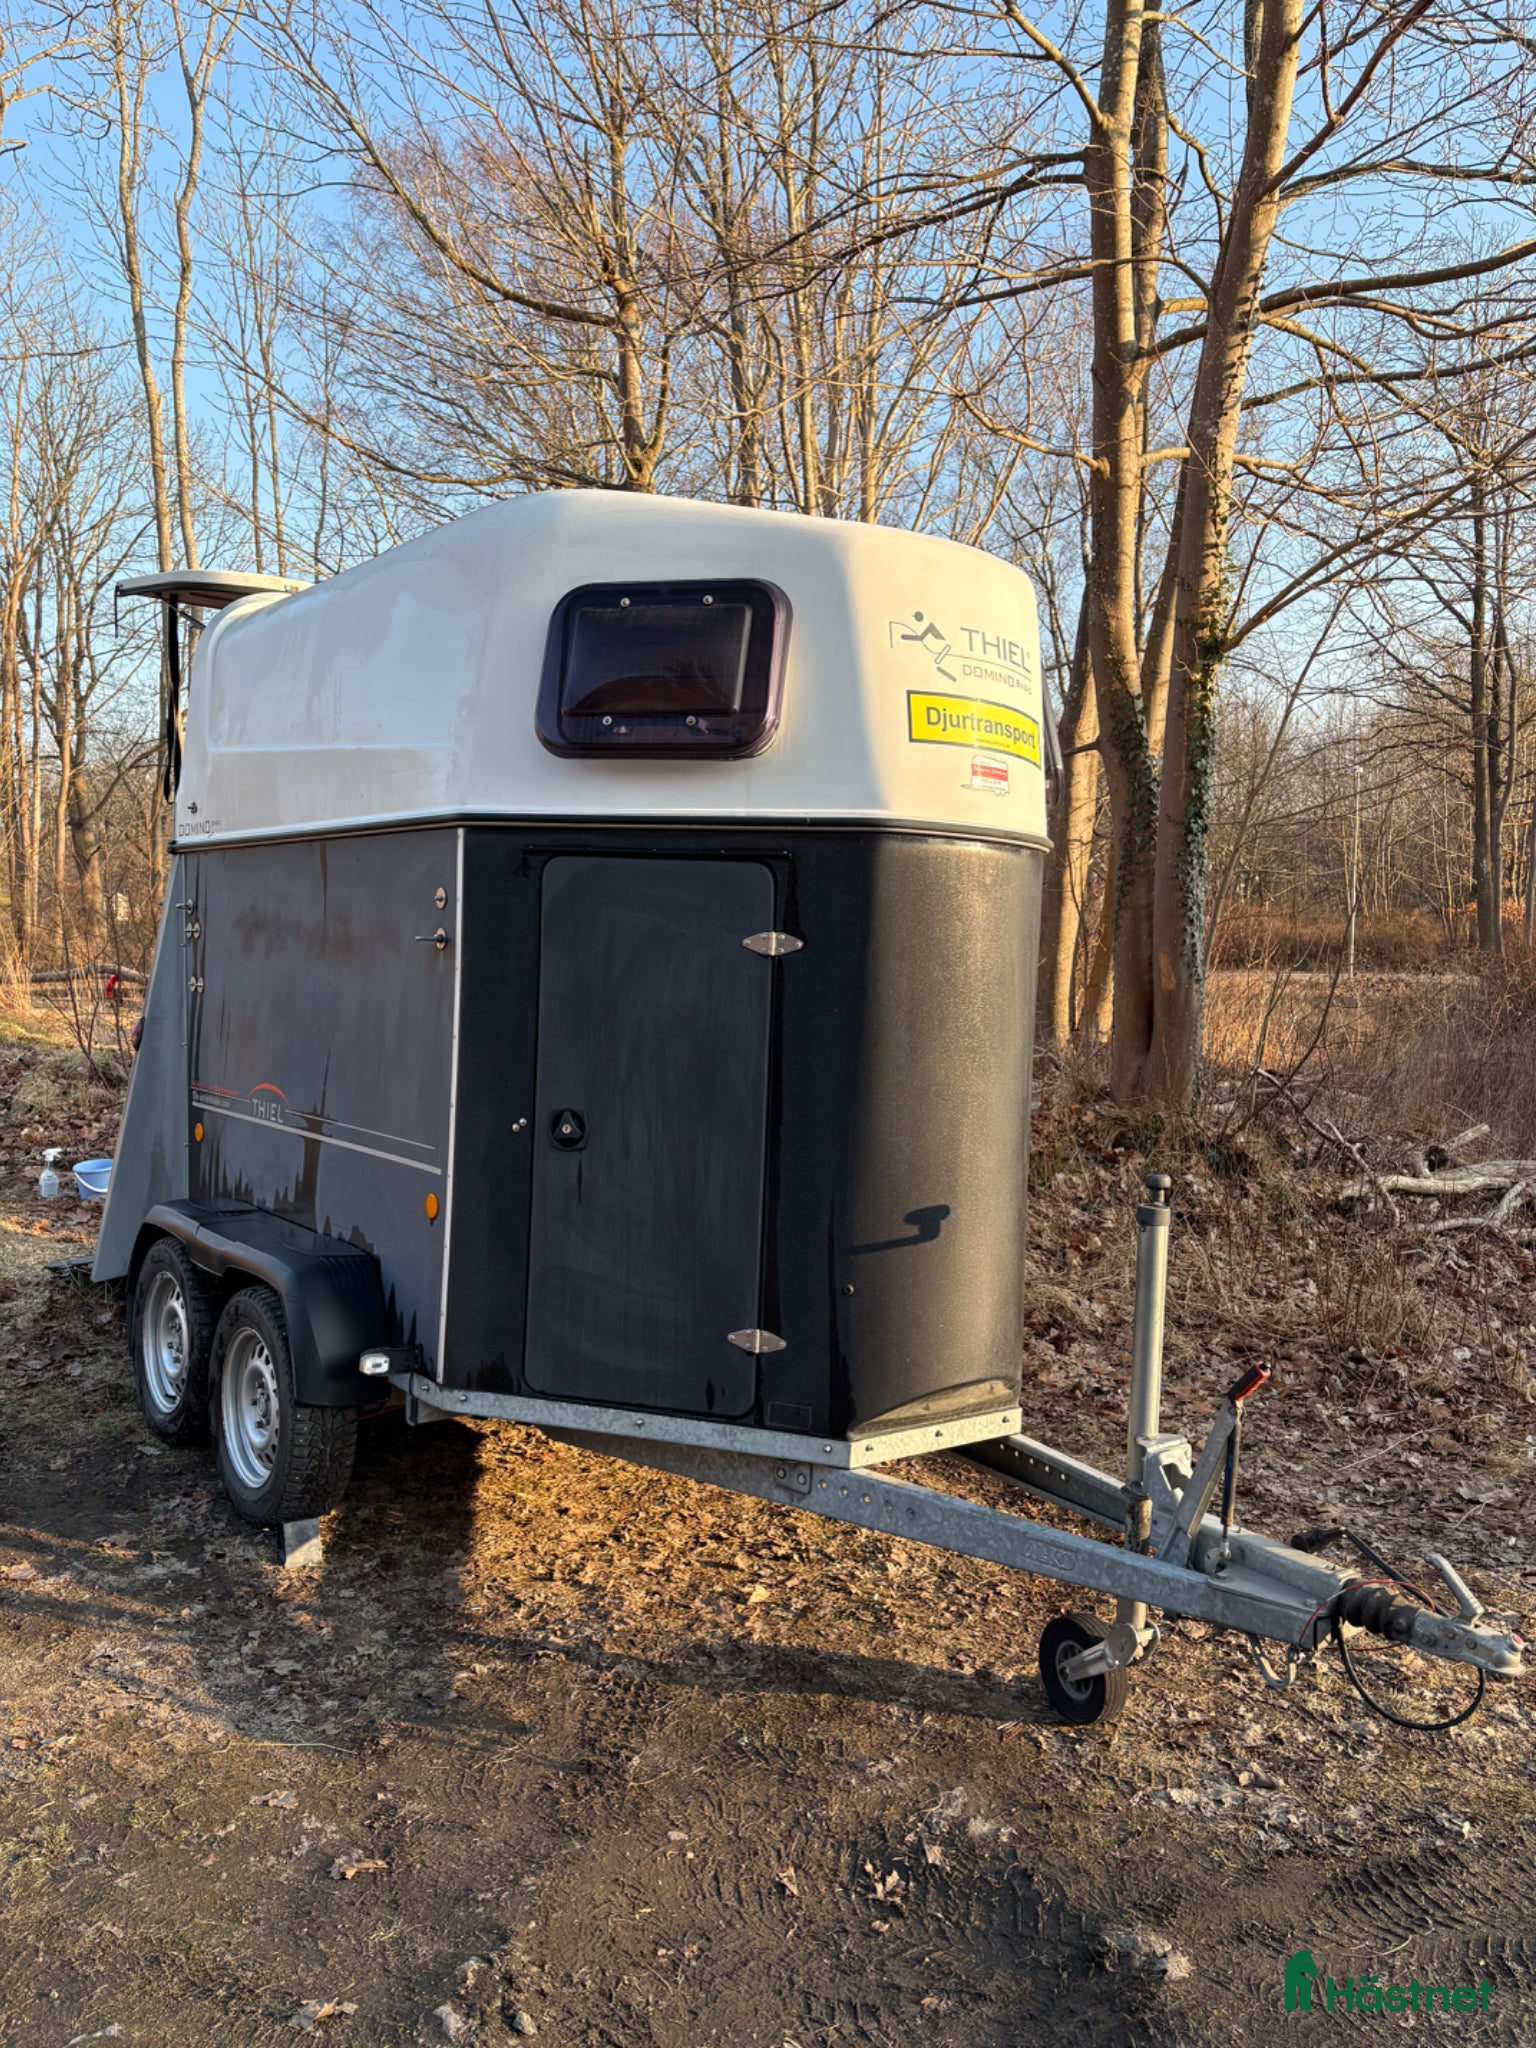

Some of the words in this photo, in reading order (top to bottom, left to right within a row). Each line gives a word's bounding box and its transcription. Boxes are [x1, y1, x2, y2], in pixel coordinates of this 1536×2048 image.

[960, 626, 1032, 674] THIEL
[961, 663, 1015, 688] DOMINO
[926, 706, 1036, 750] Djurtransport
[251, 1098, 284, 1123] THIEL
